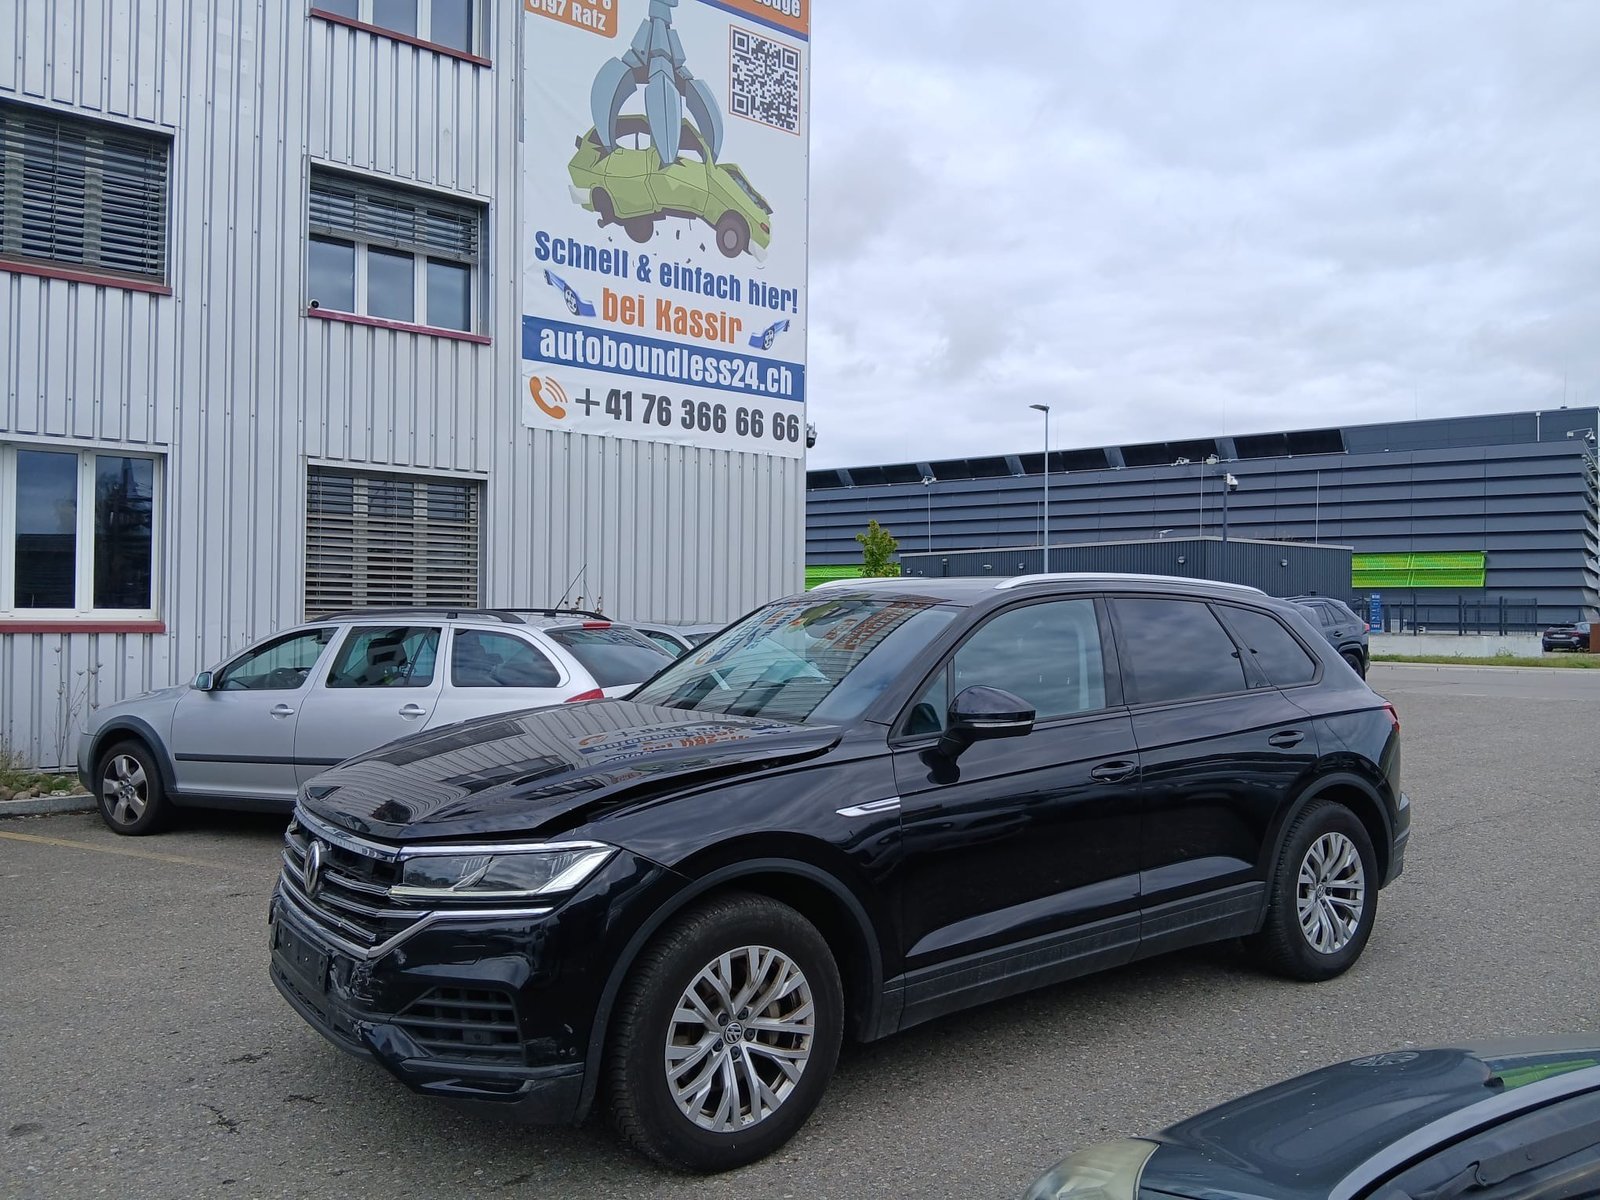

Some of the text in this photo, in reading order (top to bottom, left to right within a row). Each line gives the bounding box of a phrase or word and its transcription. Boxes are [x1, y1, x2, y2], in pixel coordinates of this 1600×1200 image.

[535, 230, 798, 314] Schnell & einfach hier!
[602, 287, 743, 344] bei Kassir
[539, 328, 793, 395] autoboundless24.ch
[641, 393, 672, 427] 76
[680, 399, 727, 434] 366
[735, 407, 764, 439] 66
[772, 412, 800, 443] 66
